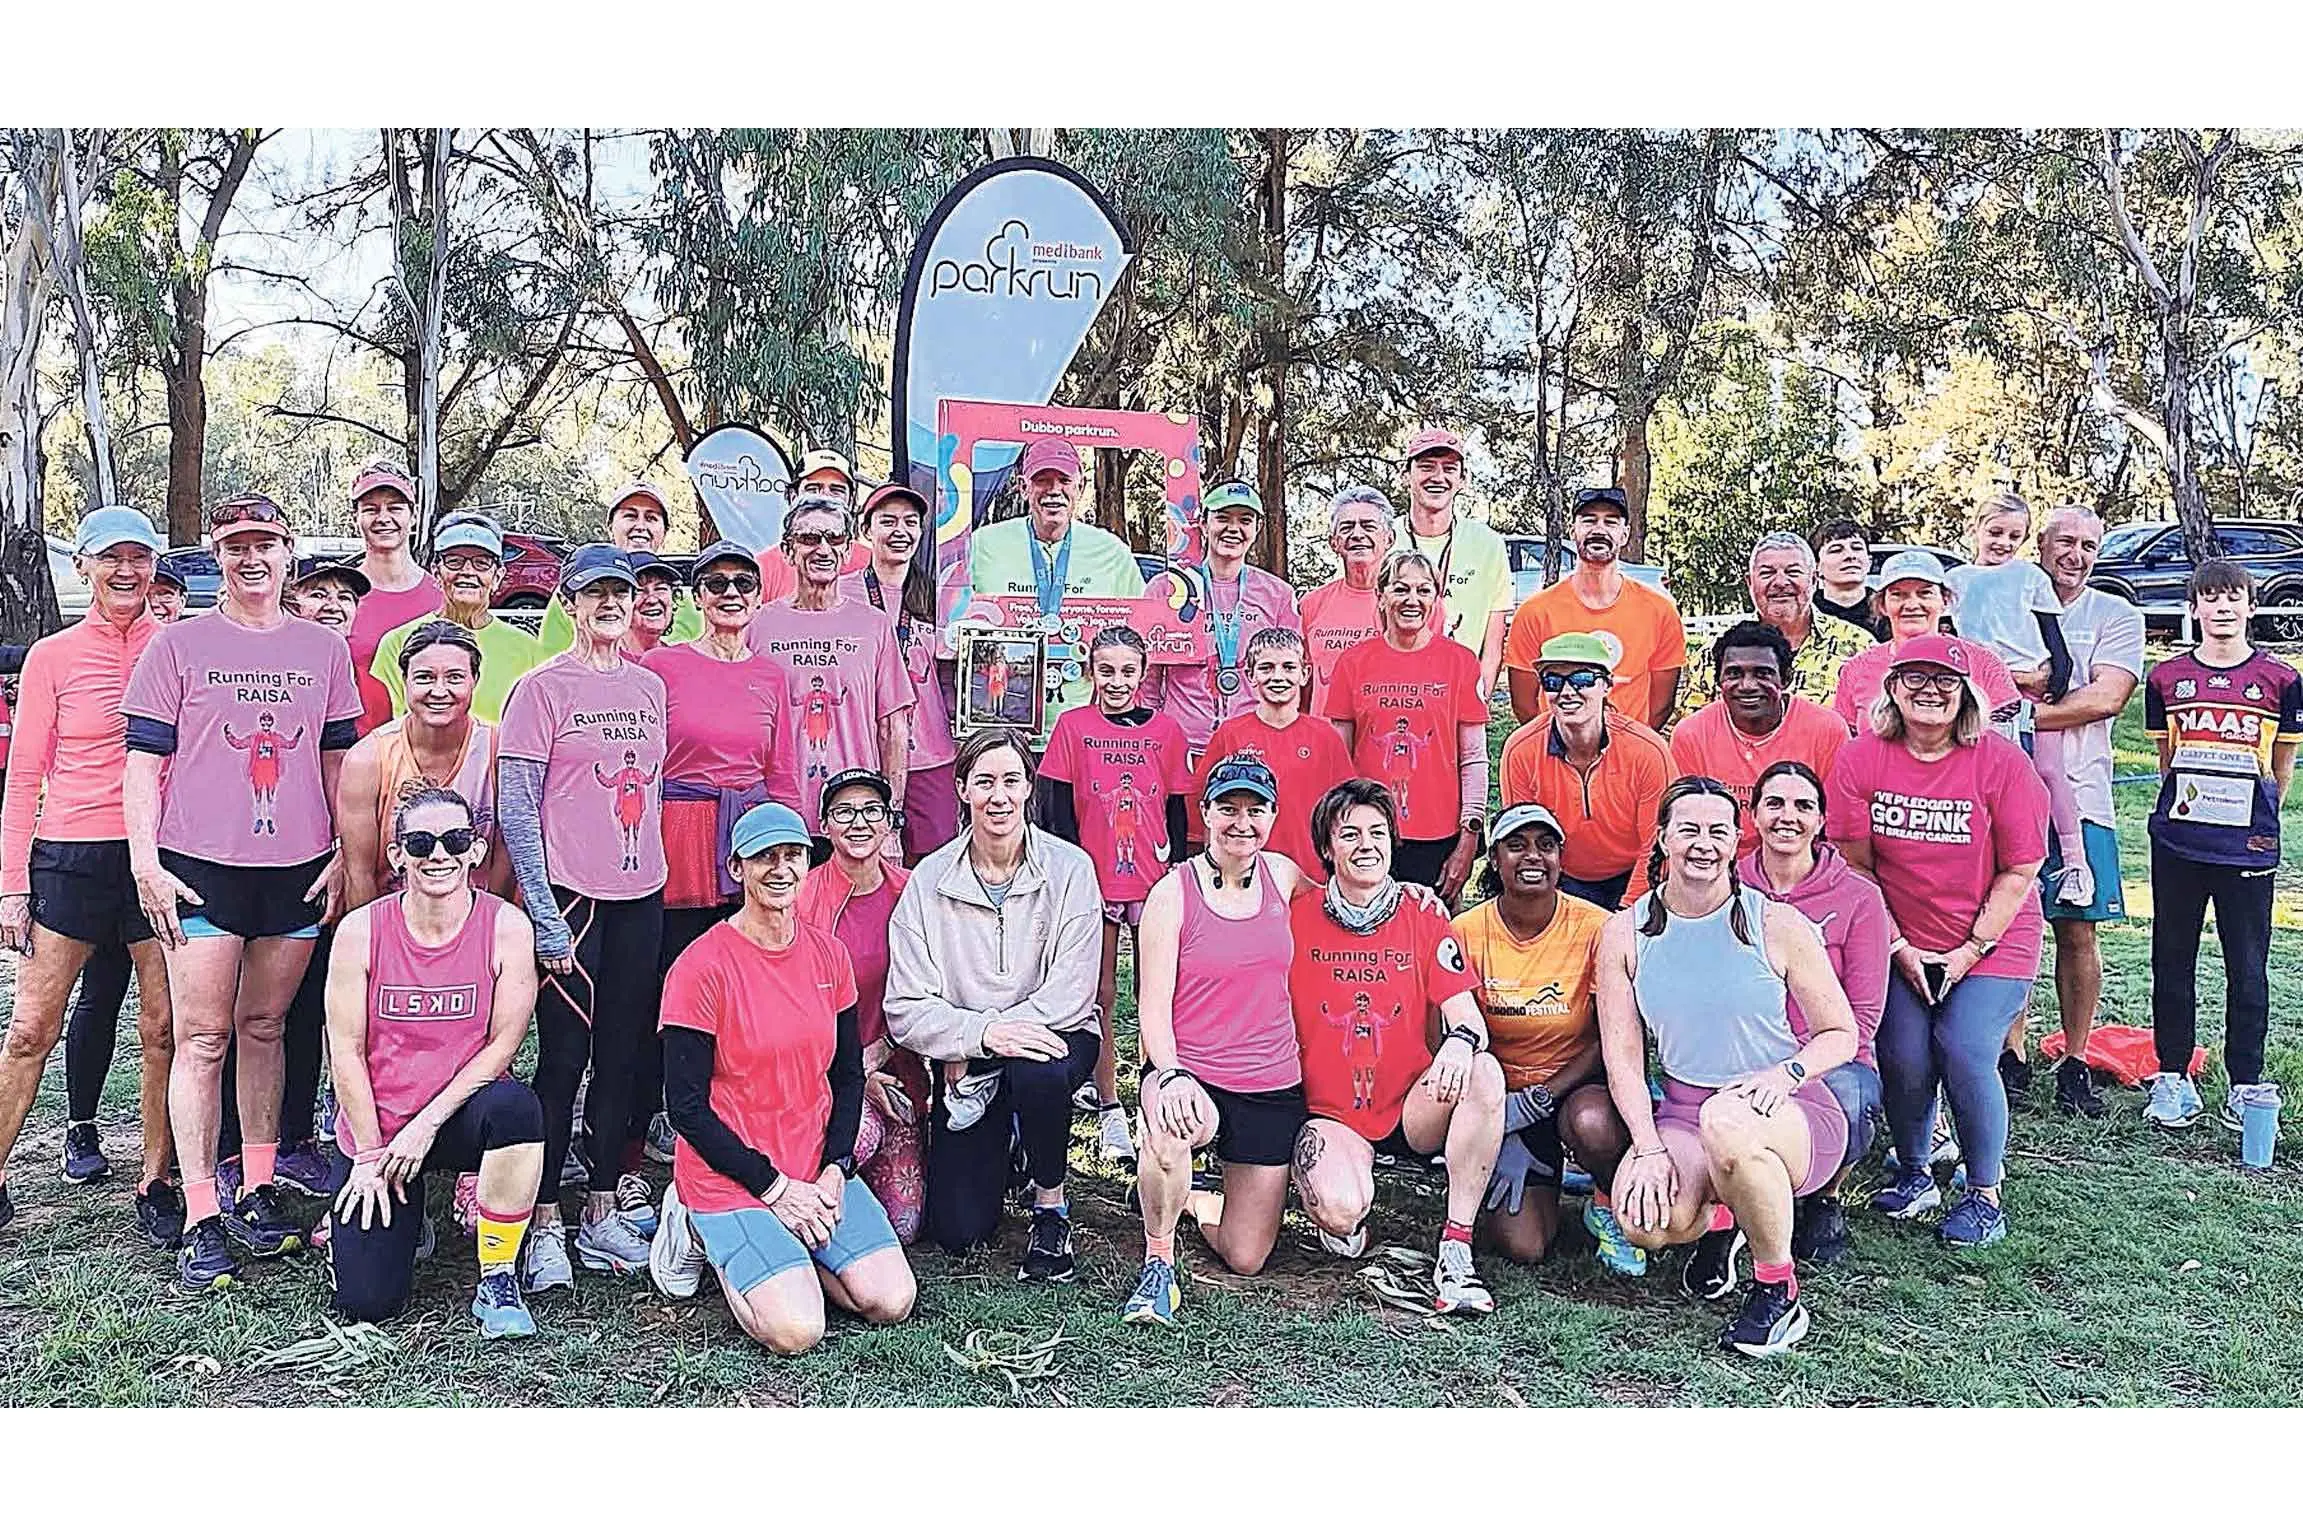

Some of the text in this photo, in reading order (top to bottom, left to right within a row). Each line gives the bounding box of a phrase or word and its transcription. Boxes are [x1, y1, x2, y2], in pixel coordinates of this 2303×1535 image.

[1033, 244, 1102, 260] medibank
[931, 221, 1101, 299] parkrun
[1021, 420, 1063, 434] Dubbo
[1450, 575, 1468, 585] For
[1064, 584, 1084, 594] For
[1313, 627, 1381, 639] Running Fo
[771, 638, 858, 653] Running For
[1324, 639, 1357, 650] RAIS
[793, 654, 839, 666] RAISA
[208, 670, 313, 687] Running For
[237, 688, 292, 703] RAISA
[1363, 683, 1447, 697] Running For
[1379, 697, 1425, 709] RAISA
[573, 709, 637, 727] Running
[602, 727, 648, 740] RAISA
[1084, 737, 1163, 753] Running For
[1103, 753, 1146, 765] RAISA
[1955, 800, 1973, 812] TO
[1871, 802, 1972, 833] GO PINK
[1872, 824, 1885, 835] OR
[1926, 832, 1972, 844] CANCER
[1311, 948, 1412, 966] Running For
[1333, 968, 1387, 982] RAISA
